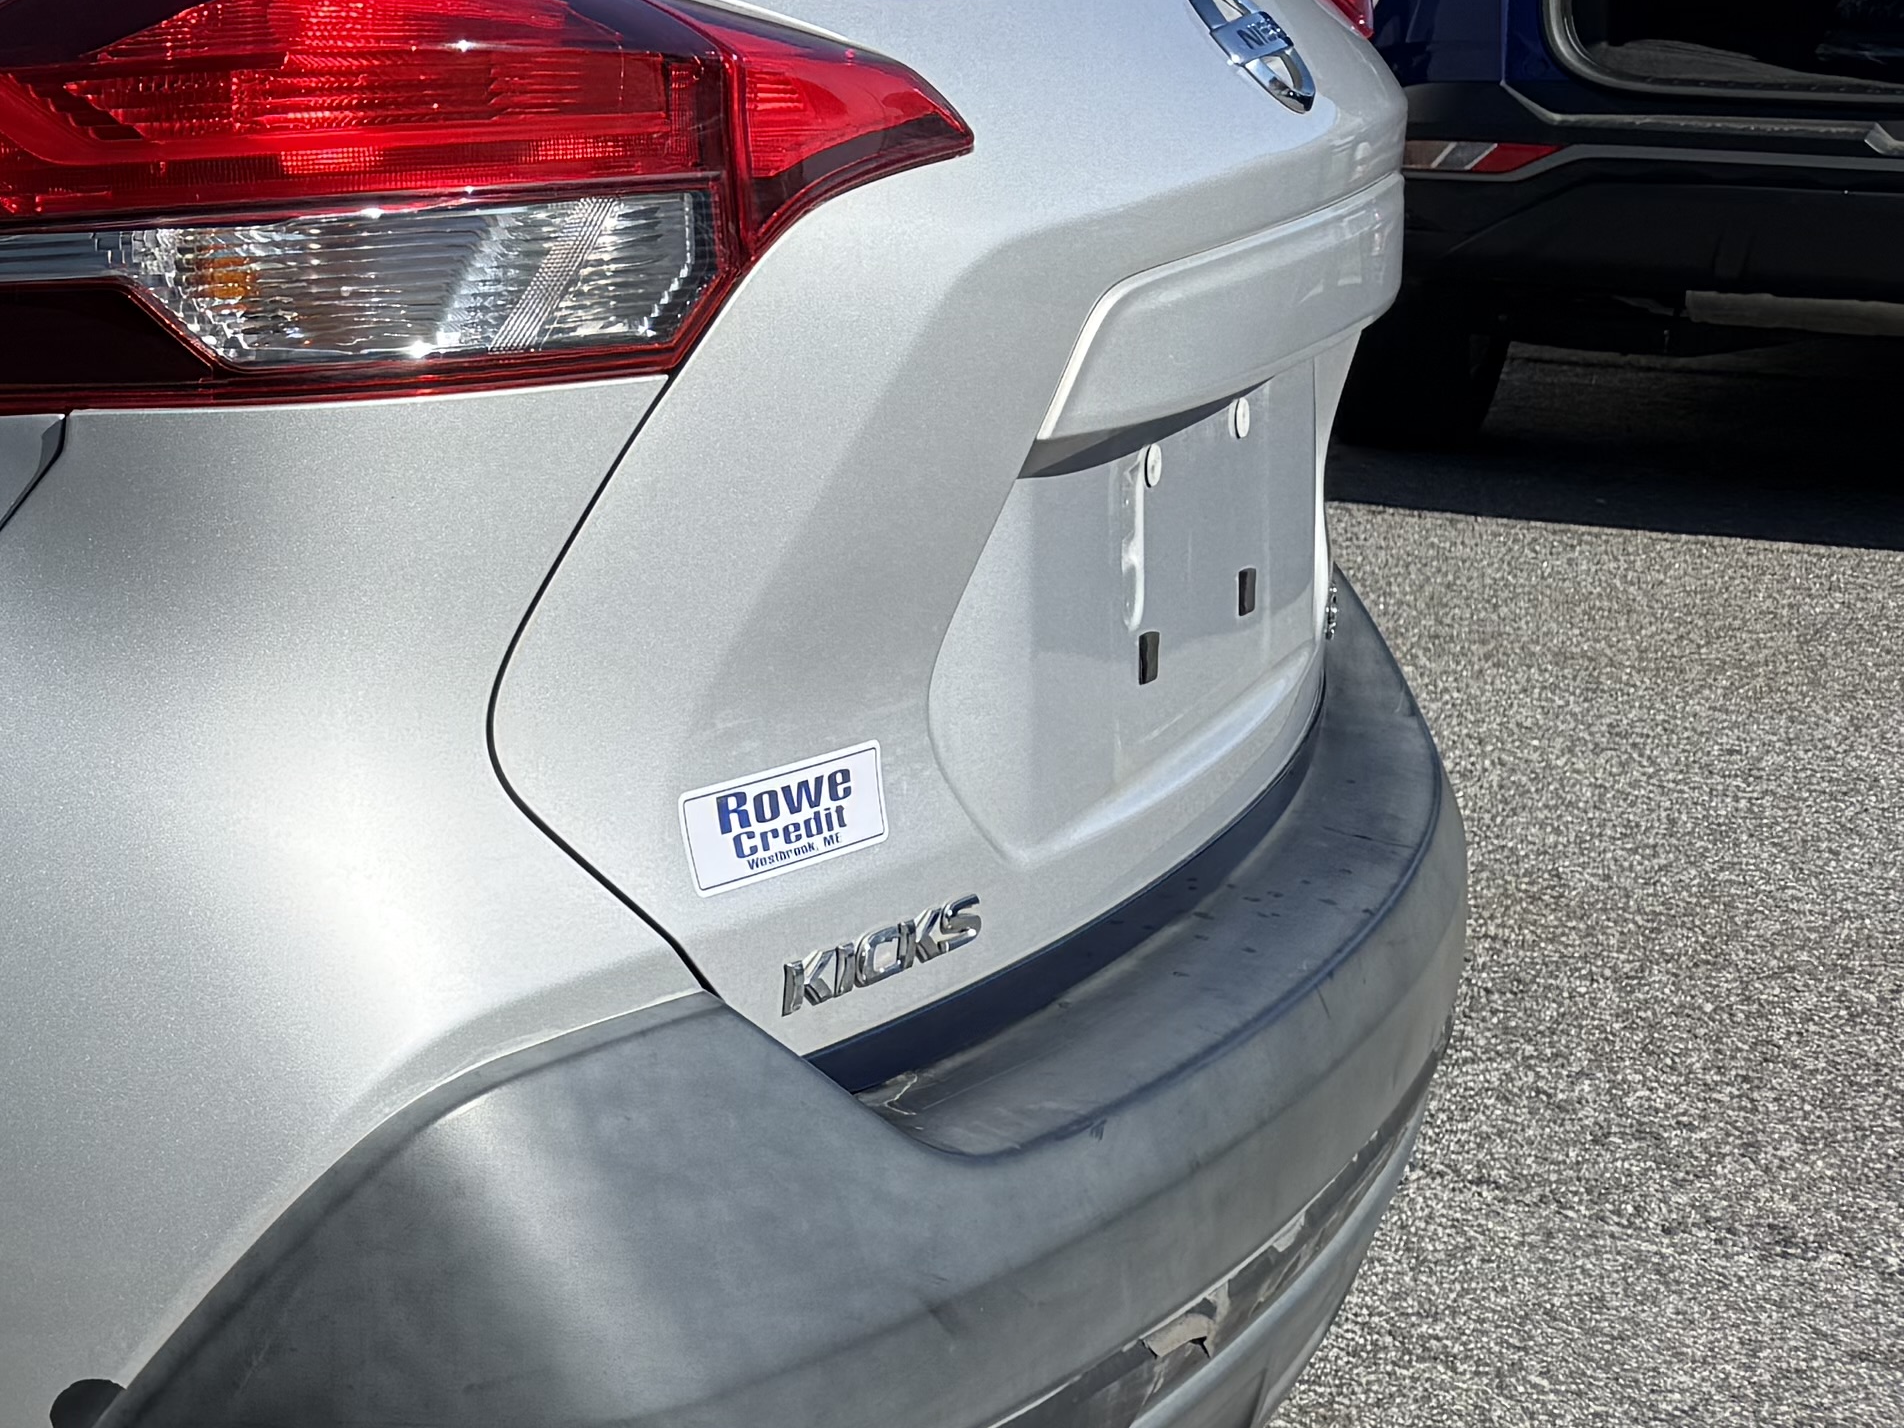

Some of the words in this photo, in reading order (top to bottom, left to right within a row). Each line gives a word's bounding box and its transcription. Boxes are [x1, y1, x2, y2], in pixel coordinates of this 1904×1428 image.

[716, 767, 853, 836] Rowe
[733, 803, 848, 860] Credit
[823, 833, 843, 848] ME
[781, 893, 982, 1017] KICKS
